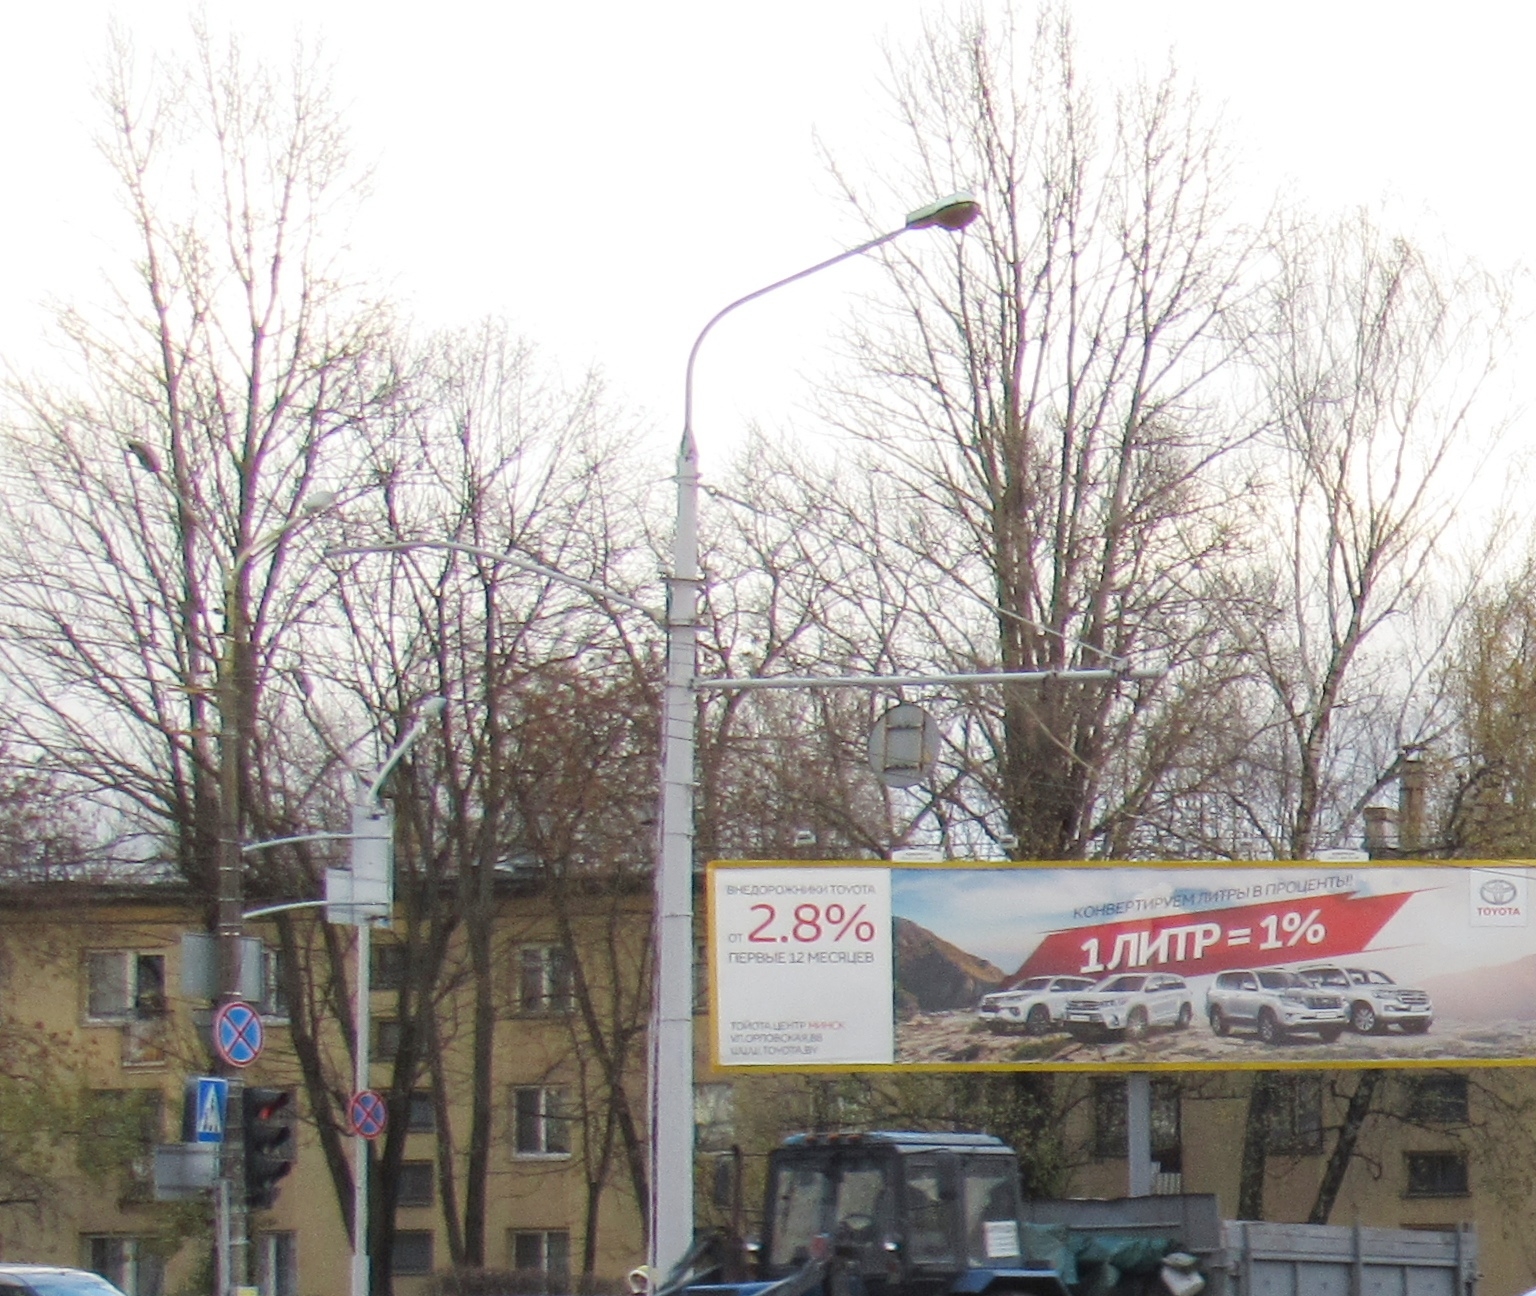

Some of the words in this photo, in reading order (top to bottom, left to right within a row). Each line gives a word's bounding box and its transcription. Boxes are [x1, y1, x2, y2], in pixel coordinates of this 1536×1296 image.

[726, 885, 827, 896] ВНЕДОРОЖНИКИ
[831, 884, 876, 895] TOYOTA
[1073, 893, 1195, 919] КОНВЕРТИРУЕМ
[1198, 888, 1250, 903] ЛИТРЫ
[1253, 885, 1262, 897] В
[748, 903, 875, 943] 2.8%
[1477, 907, 1521, 916] TOYOTA
[1079, 938, 1104, 974] 1
[1106, 922, 1221, 971] ЛИТР
[1258, 909, 1326, 950] 1%
[728, 951, 787, 964] ПЕРВЫЕ
[789, 952, 805, 964] 12
[808, 951, 875, 965] МЕСЯЦЕВ
